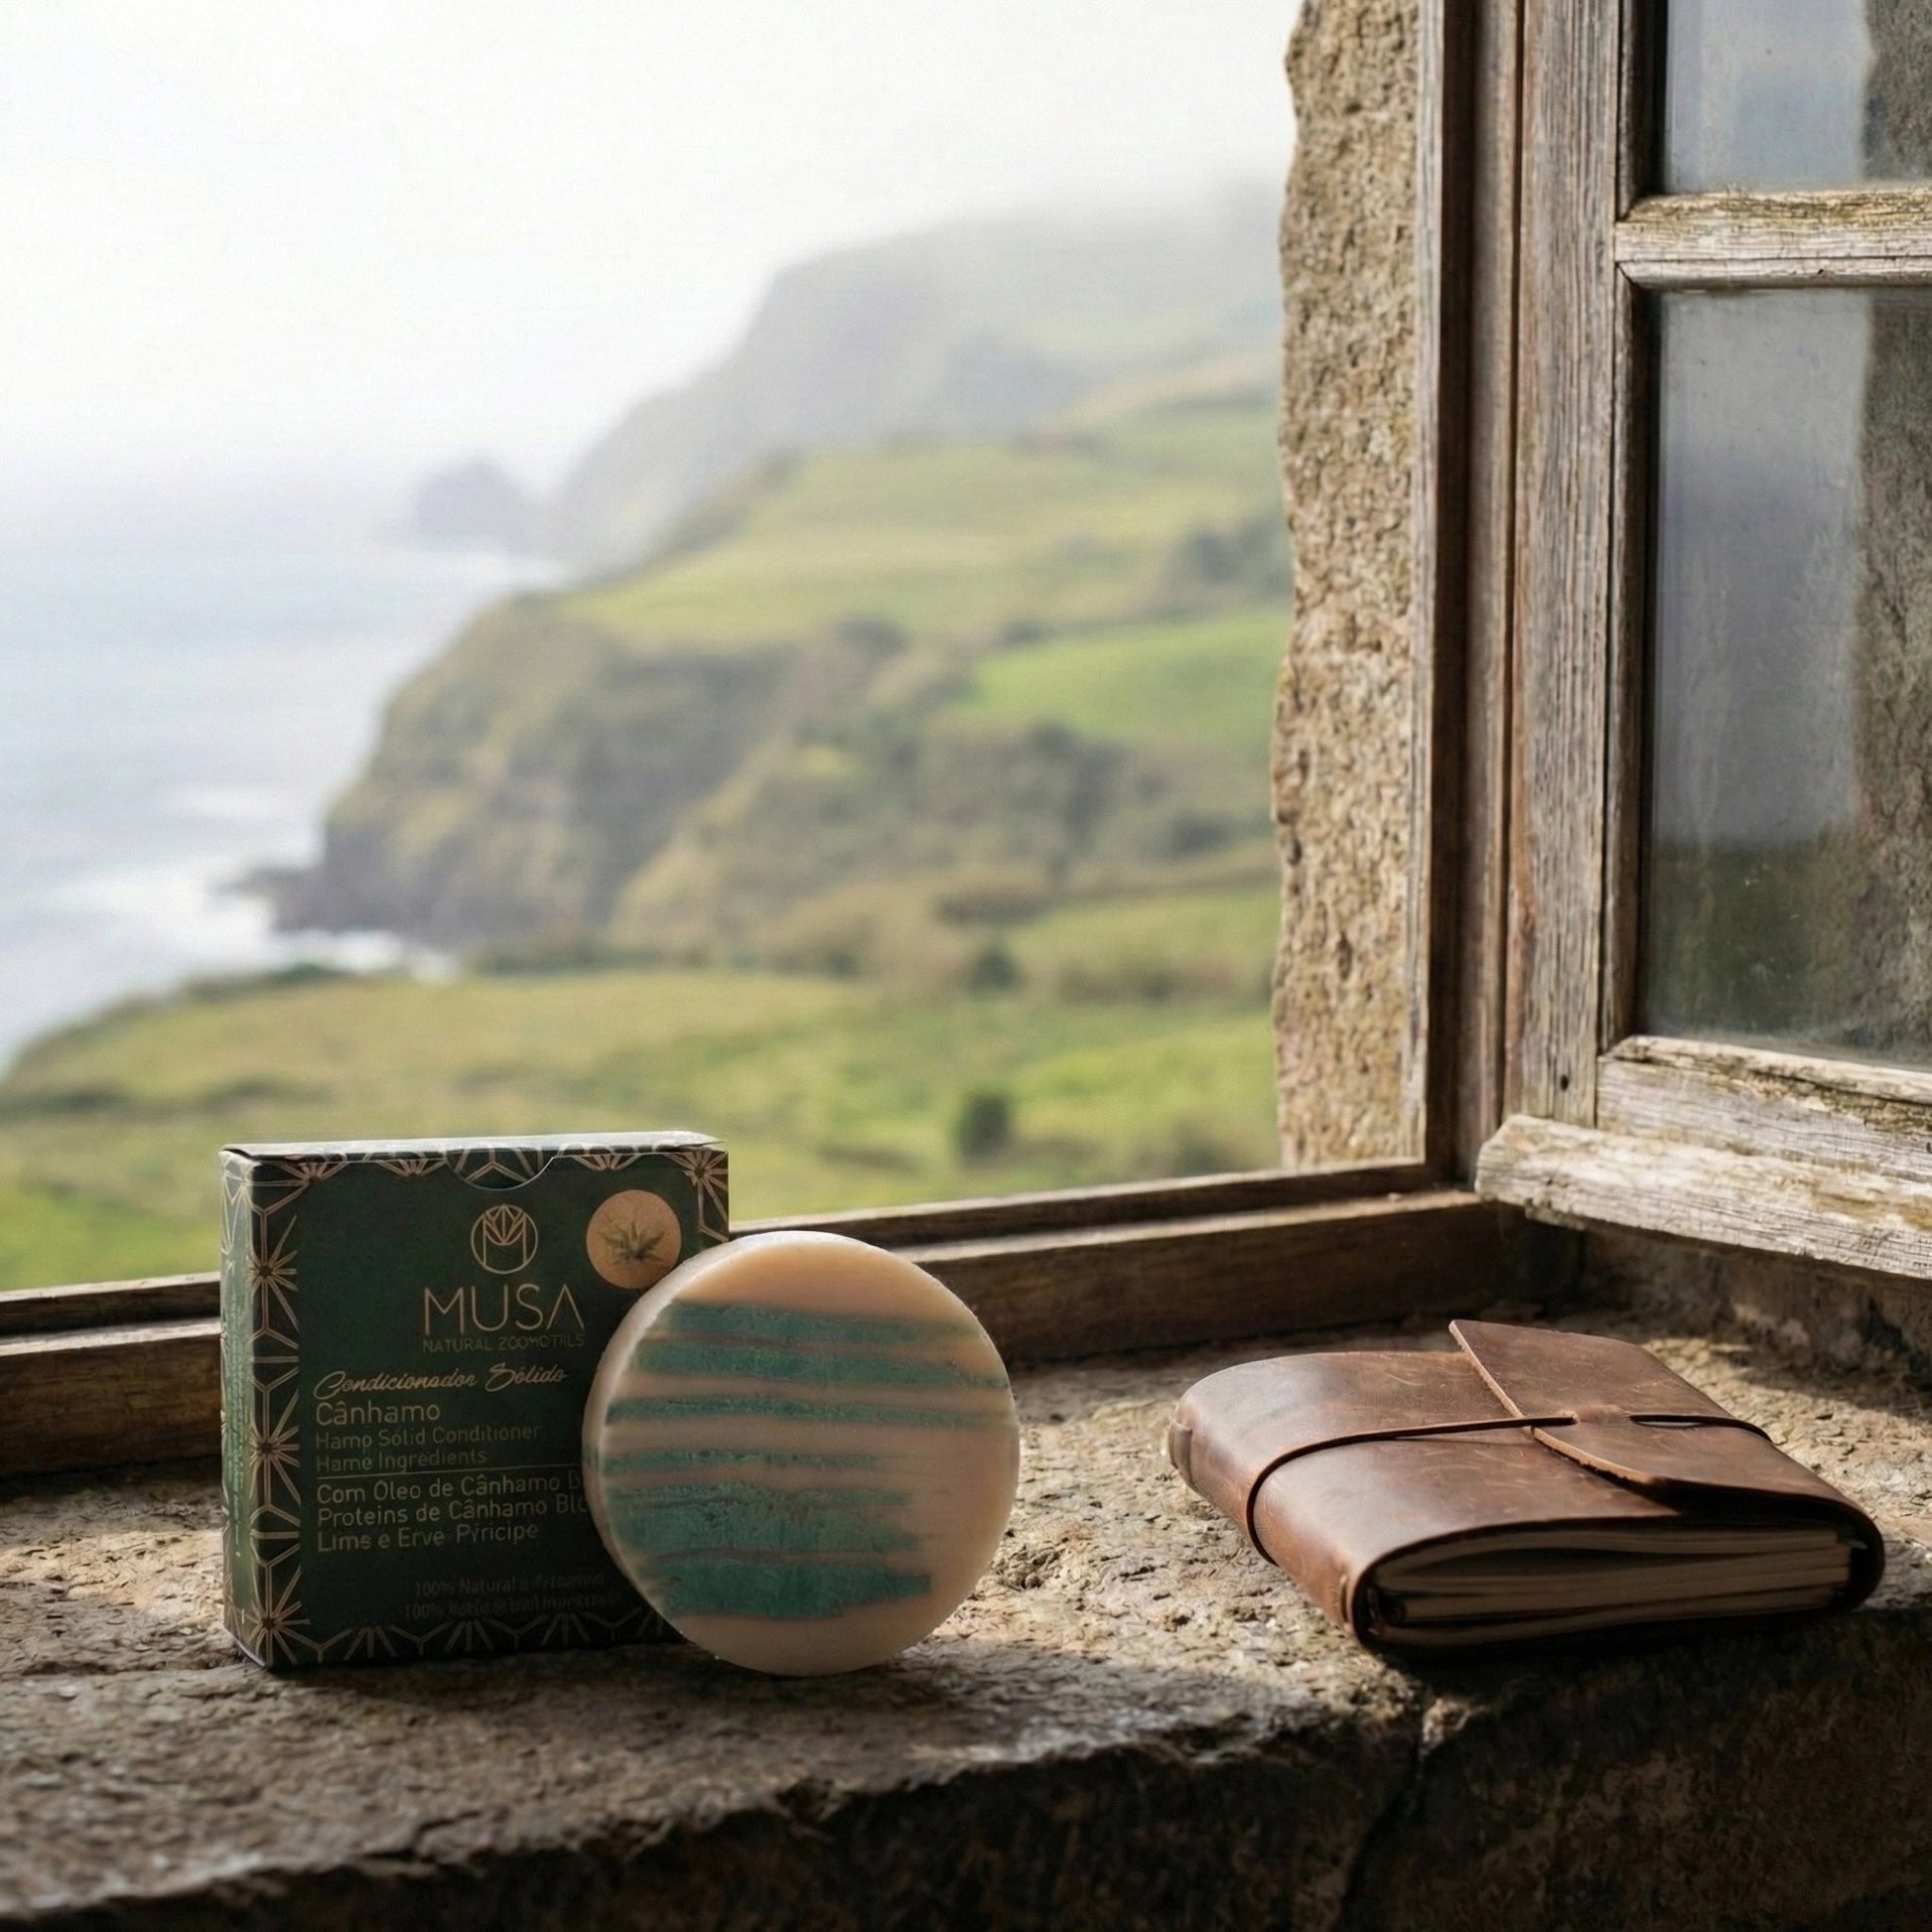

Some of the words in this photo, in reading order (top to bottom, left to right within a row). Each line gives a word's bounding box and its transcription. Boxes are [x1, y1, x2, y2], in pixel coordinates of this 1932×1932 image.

[424, 1283, 586, 1335] MUSA
[423, 1337, 493, 1353] NATURAL
[313, 1368, 479, 1400] Condicionador
[484, 1361, 570, 1393] Sólido
[316, 1399, 440, 1426] Cânhamo
[379, 1449, 487, 1473] Ingredients
[317, 1484, 365, 1504] Com
[429, 1477, 453, 1498] de
[461, 1474, 560, 1496] Cânhamo
[318, 1504, 408, 1527] Proteins
[416, 1502, 440, 1522] de
[449, 1498, 548, 1520] Cânhamo
[398, 1526, 445, 1548] Erve
